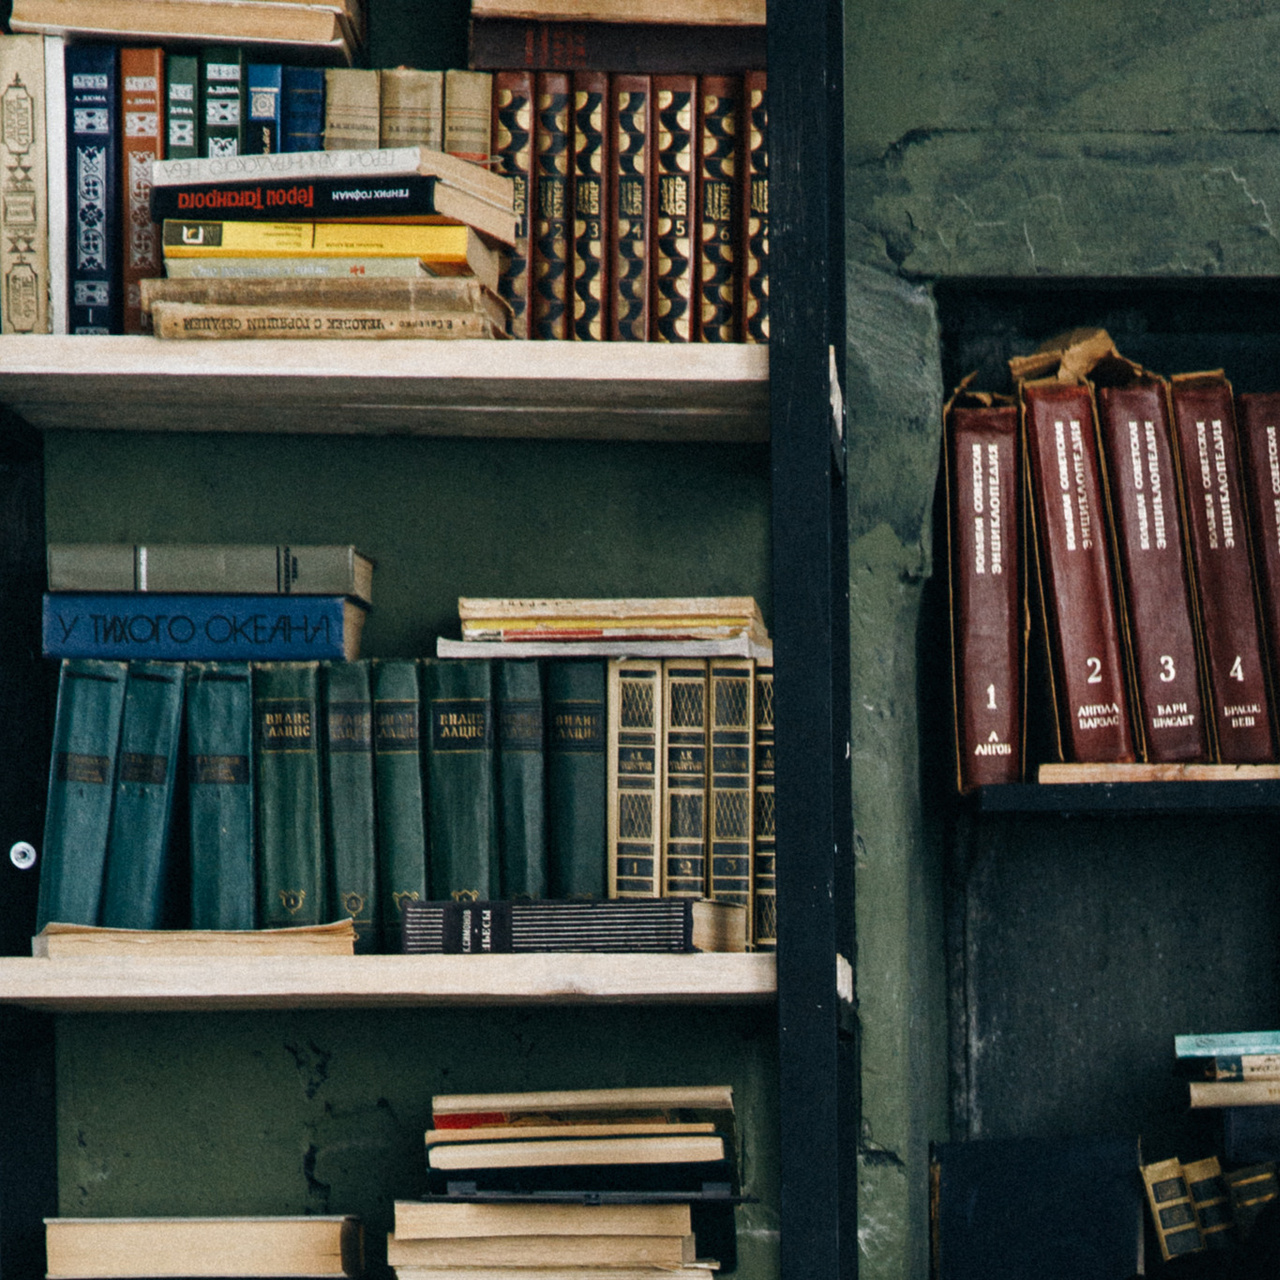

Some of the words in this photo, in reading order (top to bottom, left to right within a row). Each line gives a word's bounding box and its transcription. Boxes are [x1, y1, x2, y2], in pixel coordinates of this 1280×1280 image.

[178, 187, 264, 210] Таганрога
[266, 185, 314, 207] Герои
[332, 189, 372, 201] ГОФМАН
[373, 187, 410, 200] ГЕНРИХ
[588, 181, 600, 216] КУПЕР
[675, 176, 687, 217] КУПЕР
[589, 222, 599, 239] 3
[675, 219, 686, 237] 5
[719, 226, 730, 242] 6
[246, 317, 311, 331] ГОРЯЩИМ
[326, 317, 386, 331] ЧЕЛОВЕК
[1054, 421, 1070, 491] СОВЕТСКАЯ
[972, 444, 984, 513] СОВЕТСКАЯ
[1070, 420, 1092, 550] ЭНЦИКЛОПЕДИЯ
[1145, 421, 1166, 549] ЭНЦИКЛОПЕДИЯ
[987, 444, 1002, 575] ЭНЦИКЛОПЕДИЯ
[58, 613, 80, 644] У
[88, 613, 196, 644] ТИХОГО
[205, 613, 331, 644] ОКЕАНА
[1086, 657, 1102, 684] 2
[1159, 655, 1176, 682] 3
[1229, 655, 1244, 682] 4
[986, 684, 997, 710] 1
[265, 712, 311, 725] ВИЛИС
[267, 725, 311, 739] ЛАЦИС
[440, 726, 485, 740] ЛАЦИС
[988, 731, 999, 743] А
